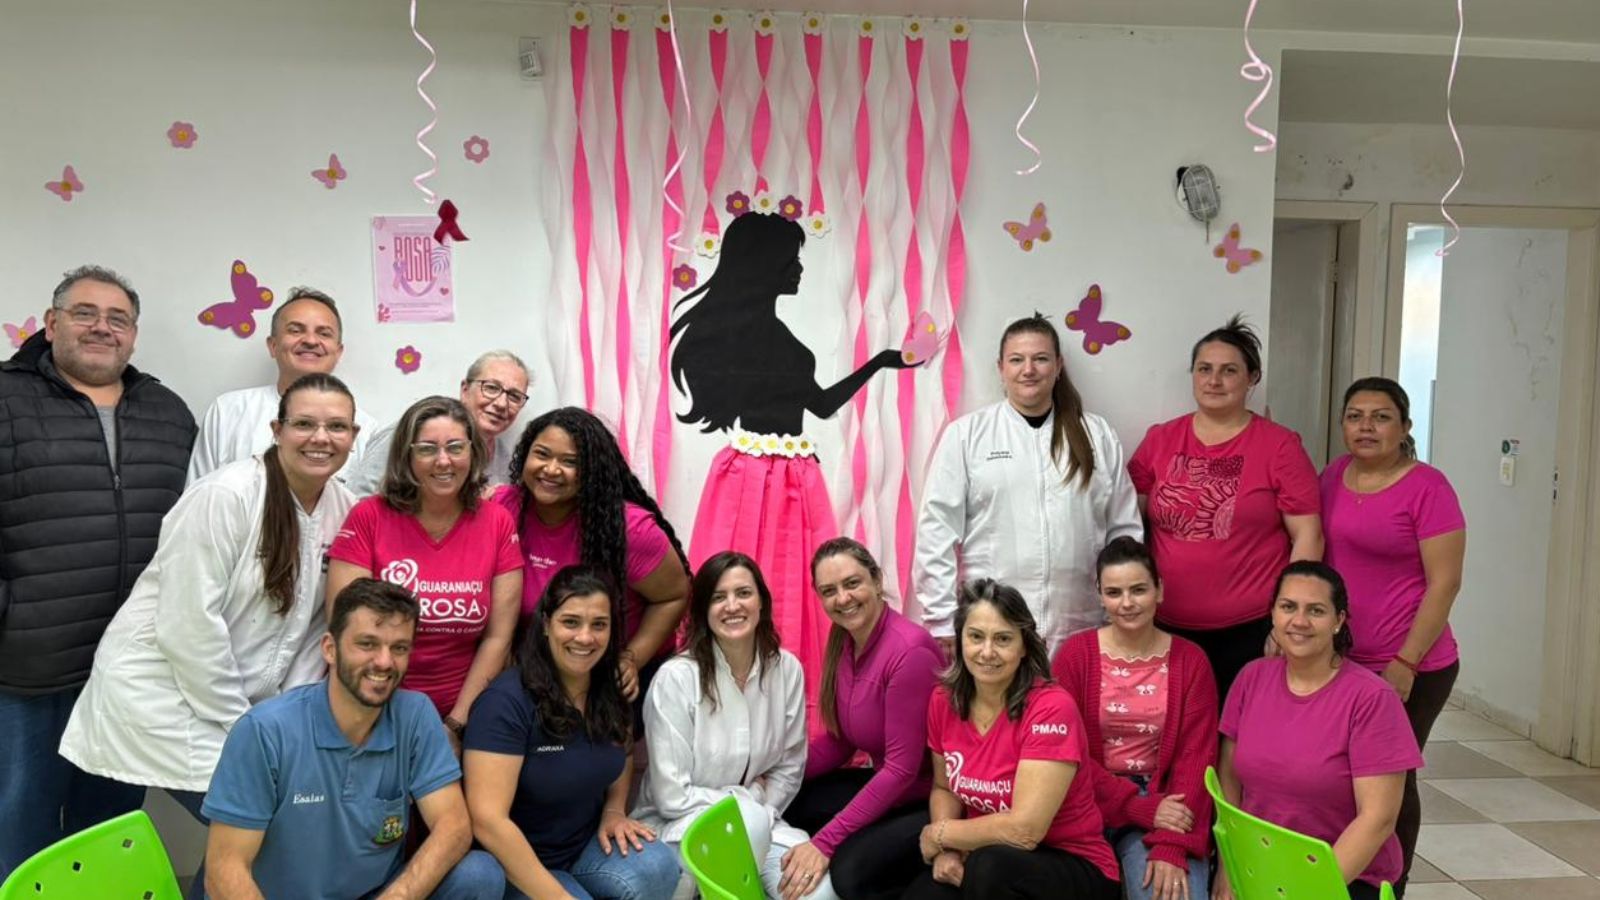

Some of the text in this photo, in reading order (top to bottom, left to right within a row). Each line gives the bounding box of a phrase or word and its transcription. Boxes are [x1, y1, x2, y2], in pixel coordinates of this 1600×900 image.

[394, 236, 432, 282] ROSA
[420, 580, 483, 595] GUARANIAÇU
[420, 598, 481, 617] ROSA
[425, 626, 455, 634] CONTRA
[1032, 724, 1068, 735] PMAQ
[959, 776, 1011, 797] GUARANIAÇU
[961, 793, 1011, 814] ROSA
